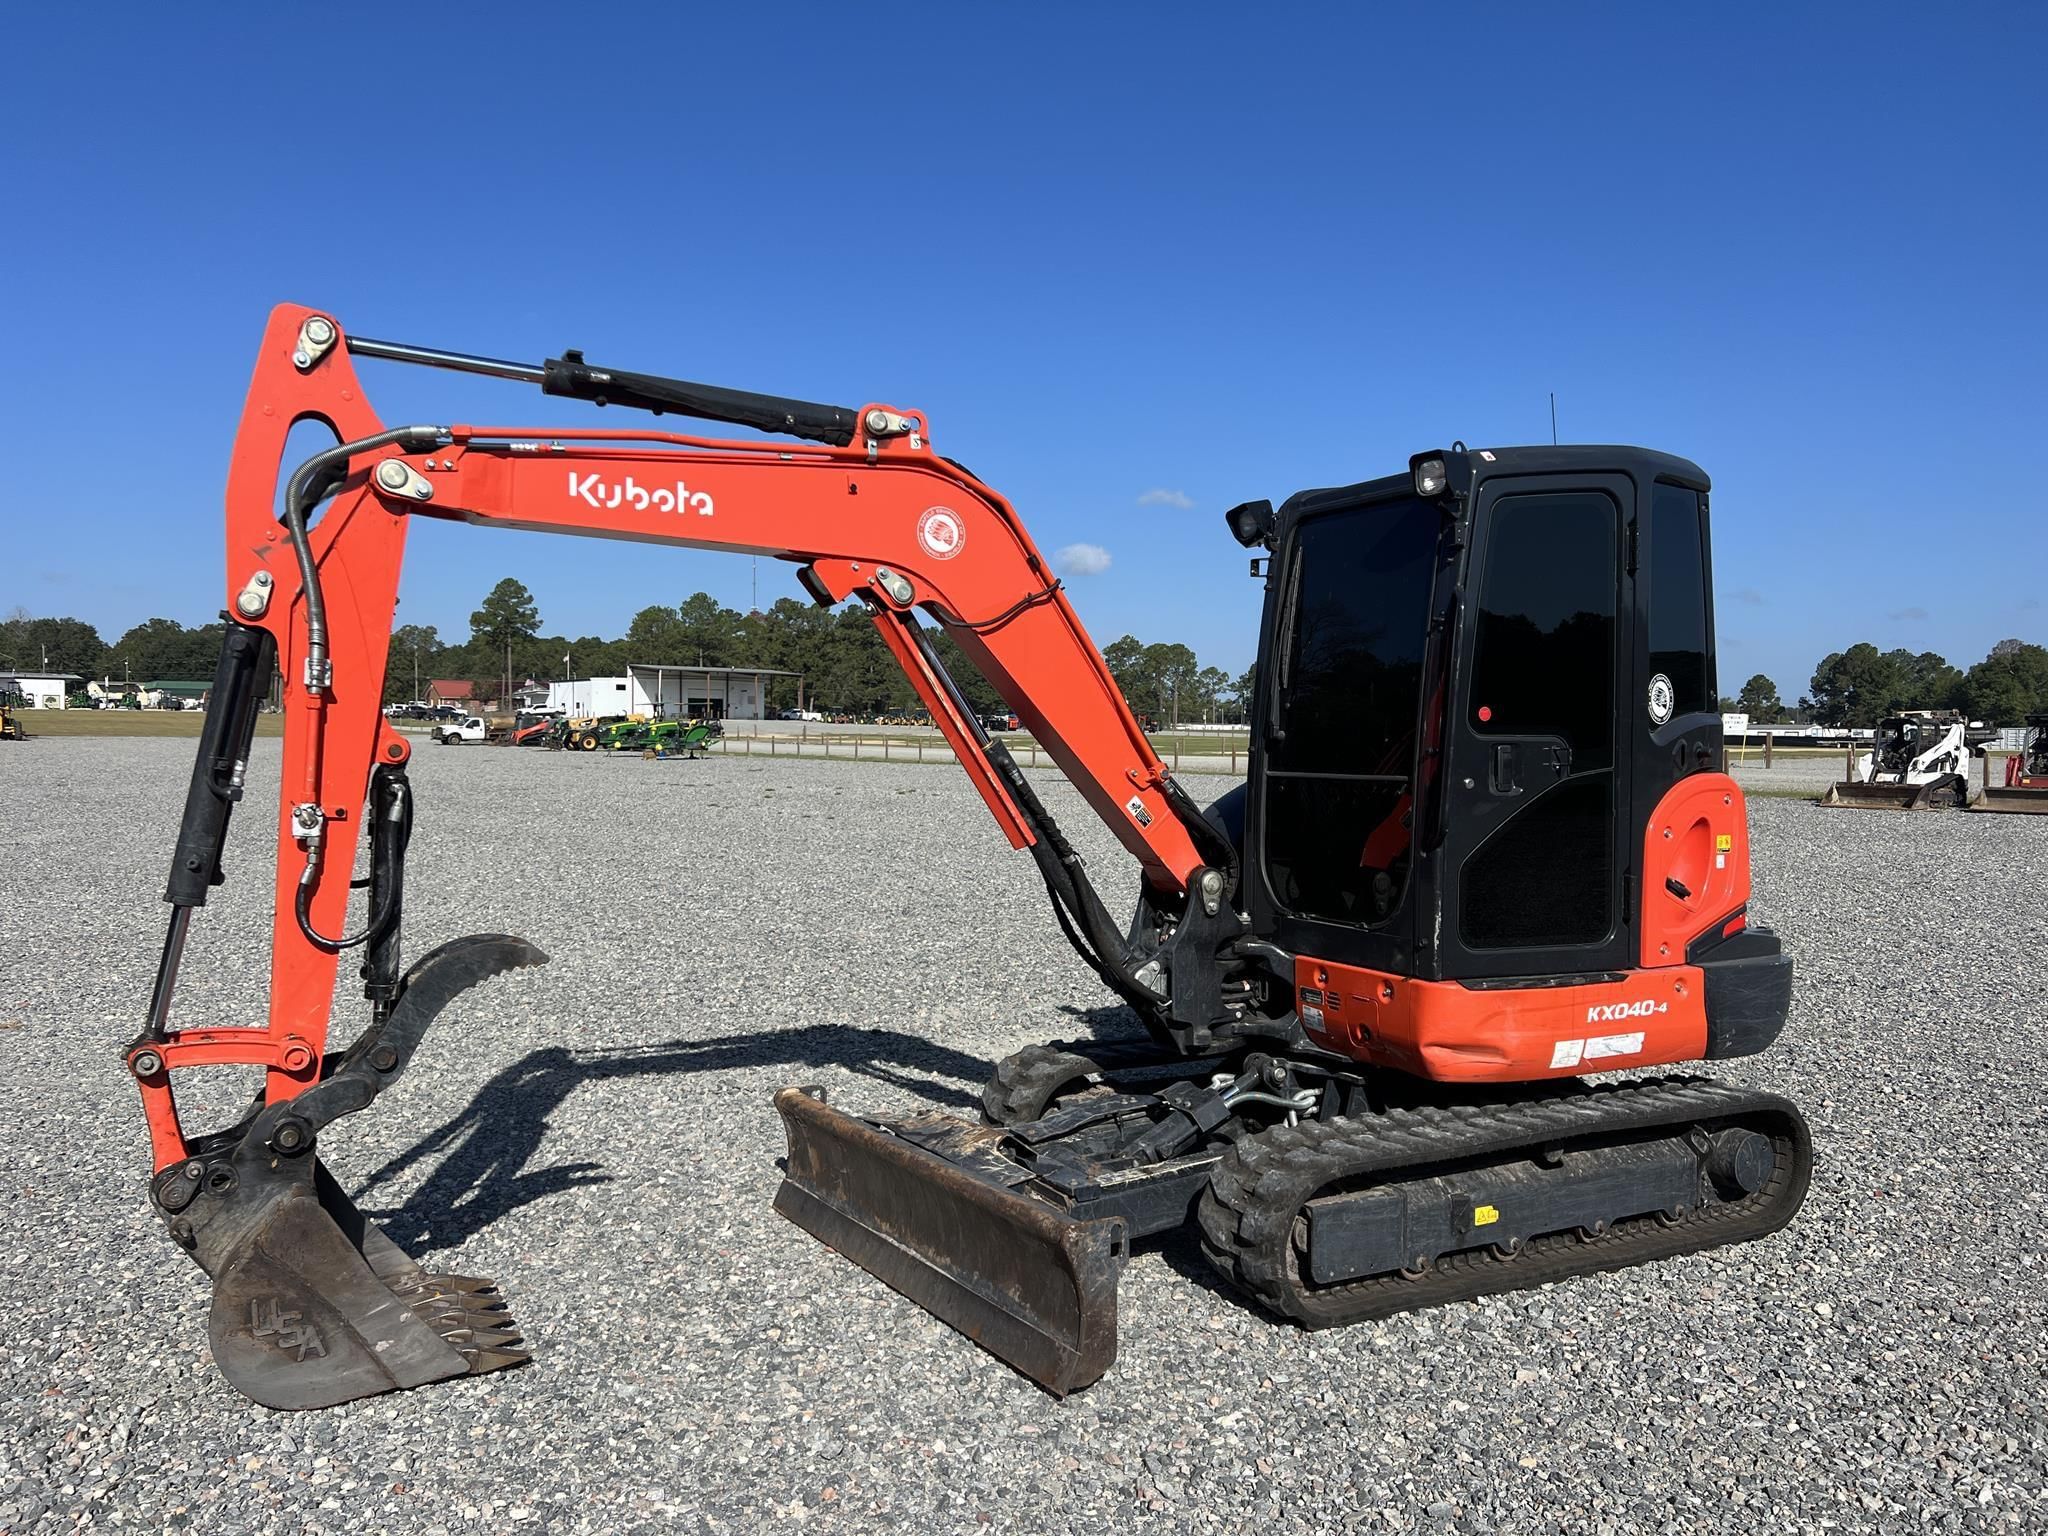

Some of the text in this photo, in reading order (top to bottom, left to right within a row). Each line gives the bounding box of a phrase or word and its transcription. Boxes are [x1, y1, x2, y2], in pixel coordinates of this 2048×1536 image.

[568, 471, 714, 516] Kubota
[1586, 999, 1668, 1023] KX040-4
[251, 1297, 327, 1362] USA
